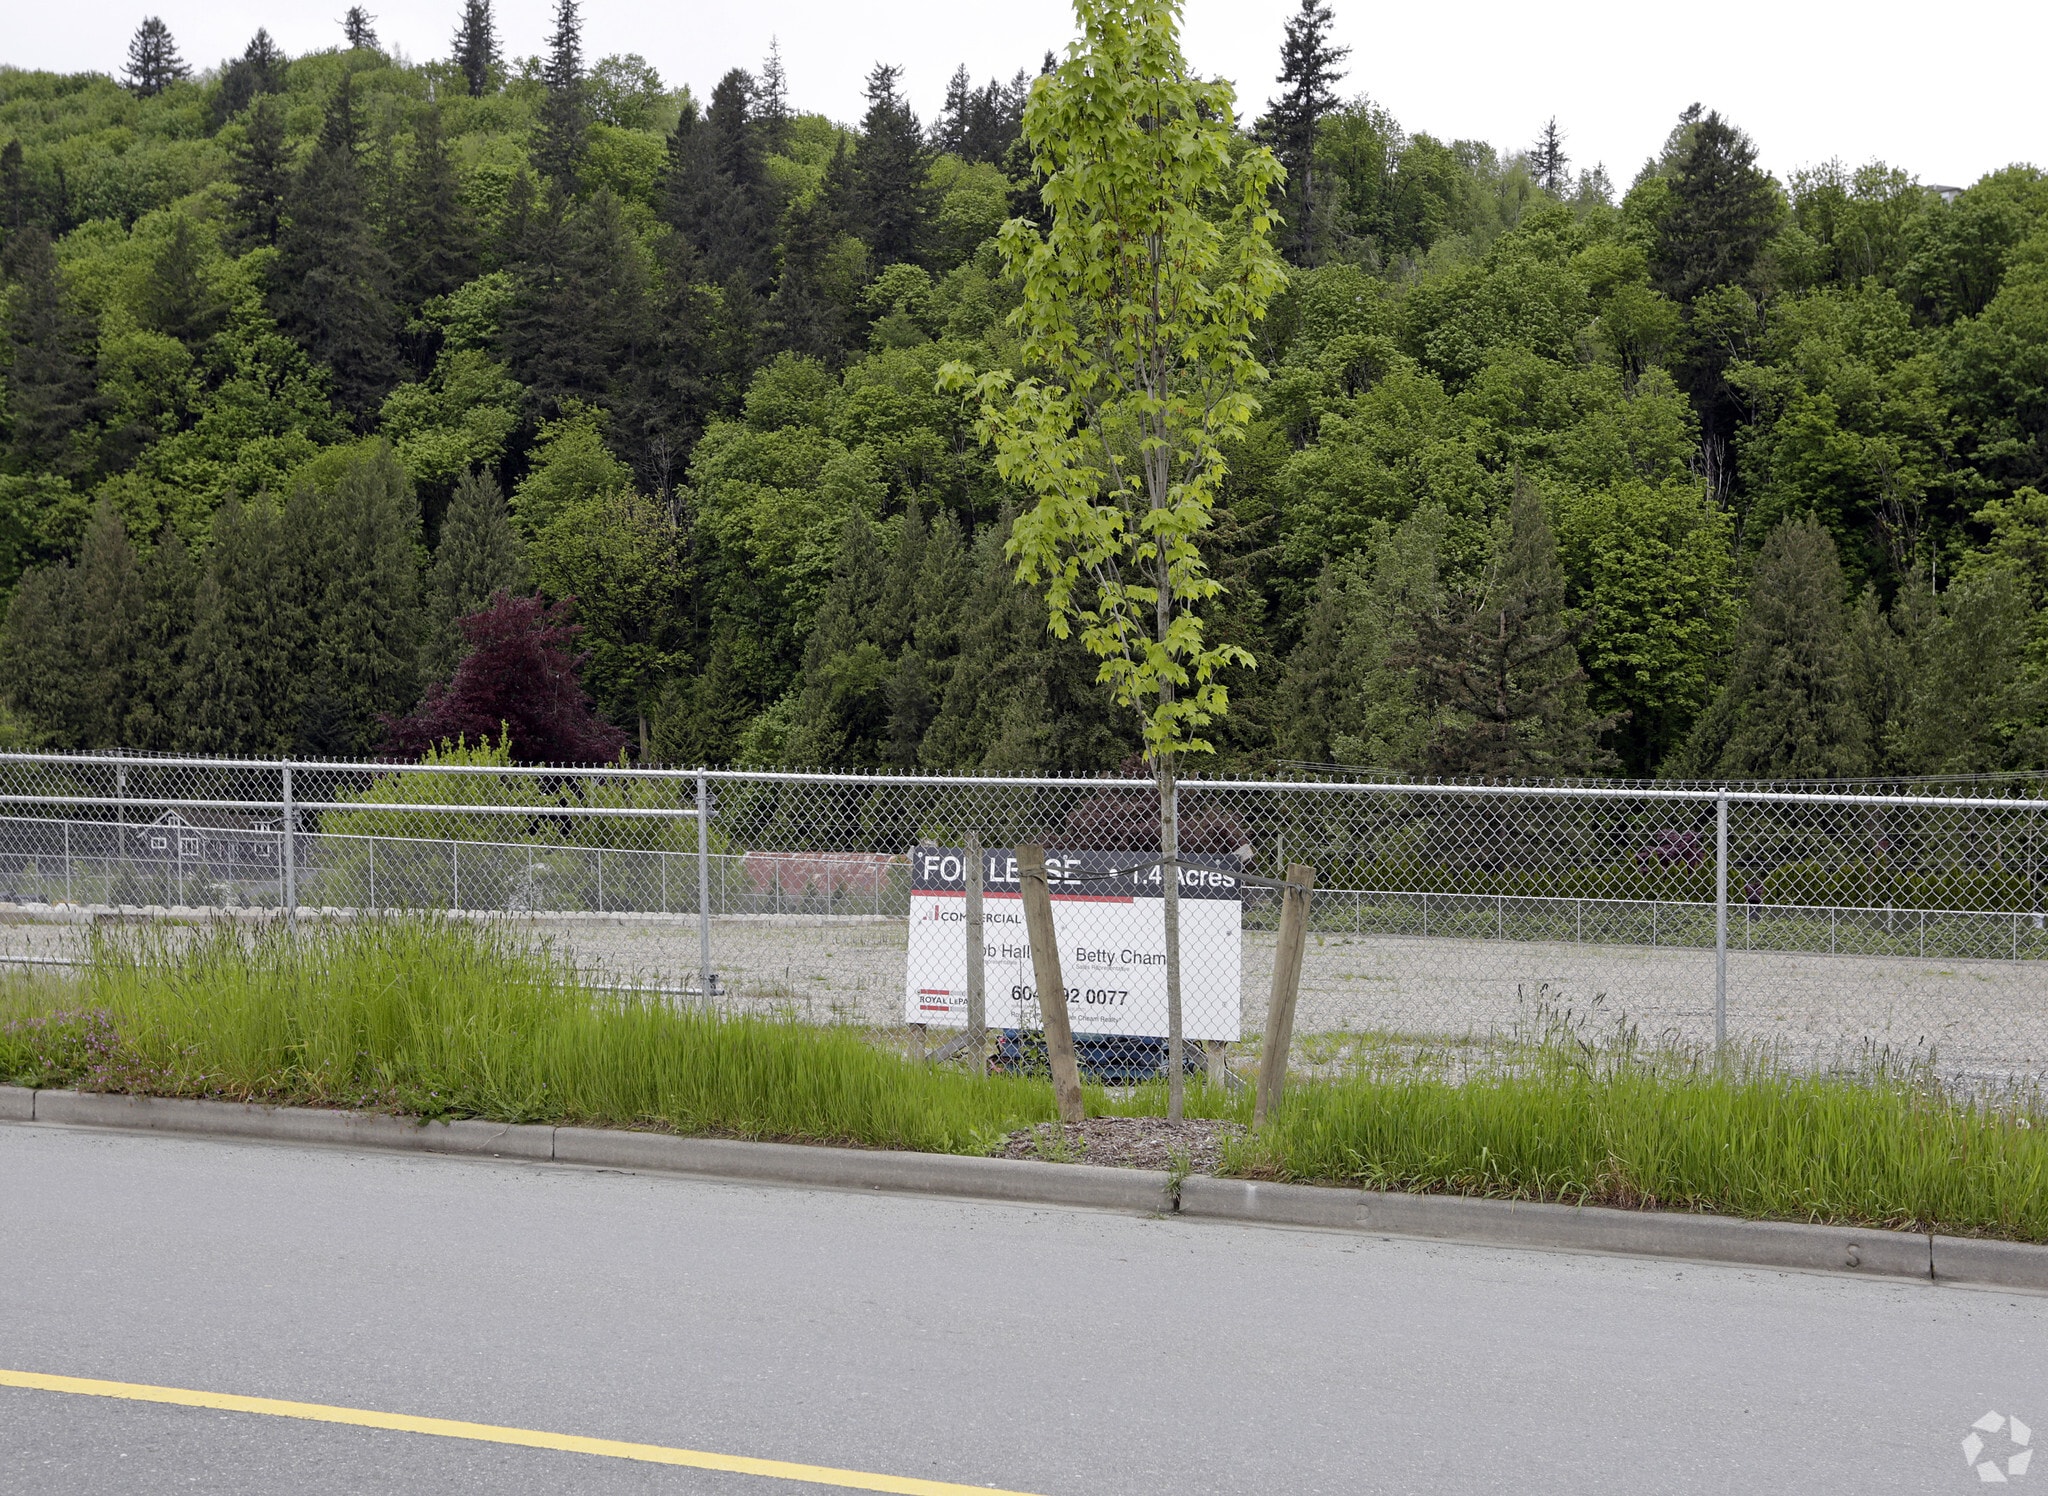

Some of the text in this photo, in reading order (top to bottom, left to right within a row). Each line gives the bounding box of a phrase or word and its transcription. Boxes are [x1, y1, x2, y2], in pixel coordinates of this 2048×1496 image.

[989, 857, 1082, 885] LESE
[1177, 866, 1236, 888] Acres
[941, 911, 1021, 924] COMRCIAL
[1076, 947, 1167, 967] Betty Cham
[919, 995, 969, 1005] ROYAL LEPA
[1063, 987, 1080, 1003] 92
[1086, 989, 1128, 1006] 0077
